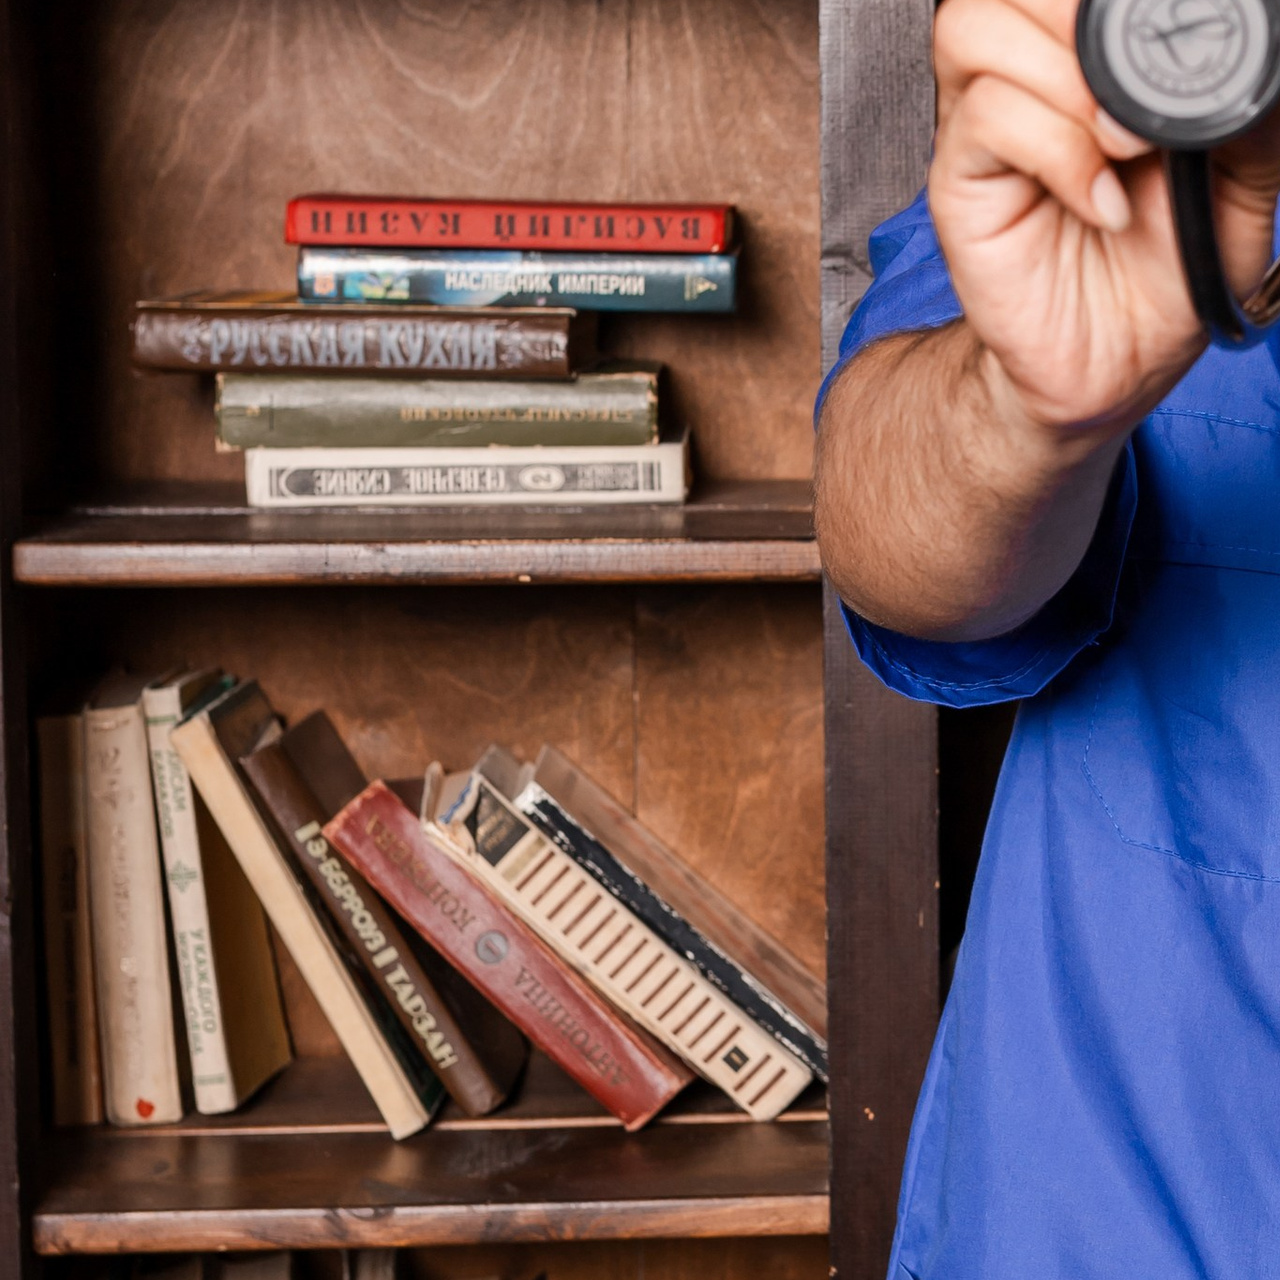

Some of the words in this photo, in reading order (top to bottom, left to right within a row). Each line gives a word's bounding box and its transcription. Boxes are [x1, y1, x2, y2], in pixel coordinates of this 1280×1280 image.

[310, 210, 459, 237] КАЗИН
[493, 213, 699, 246] ВАСИЛИЙ
[444, 270, 552, 295] НАСЛЕДНИК
[558, 274, 645, 295] ИМПЕРИИ
[209, 316, 370, 370] РУССКАЯ
[377, 318, 499, 371] КУХНЯ
[312, 467, 389, 493] СИЯНИЕ
[402, 464, 504, 493] СЕВЕРНОЕ
[361, 811, 478, 933] КОПТЯЕВА
[381, 962, 460, 1071] ТАРЗАН
[506, 963, 633, 1095] АНТОНИНА
